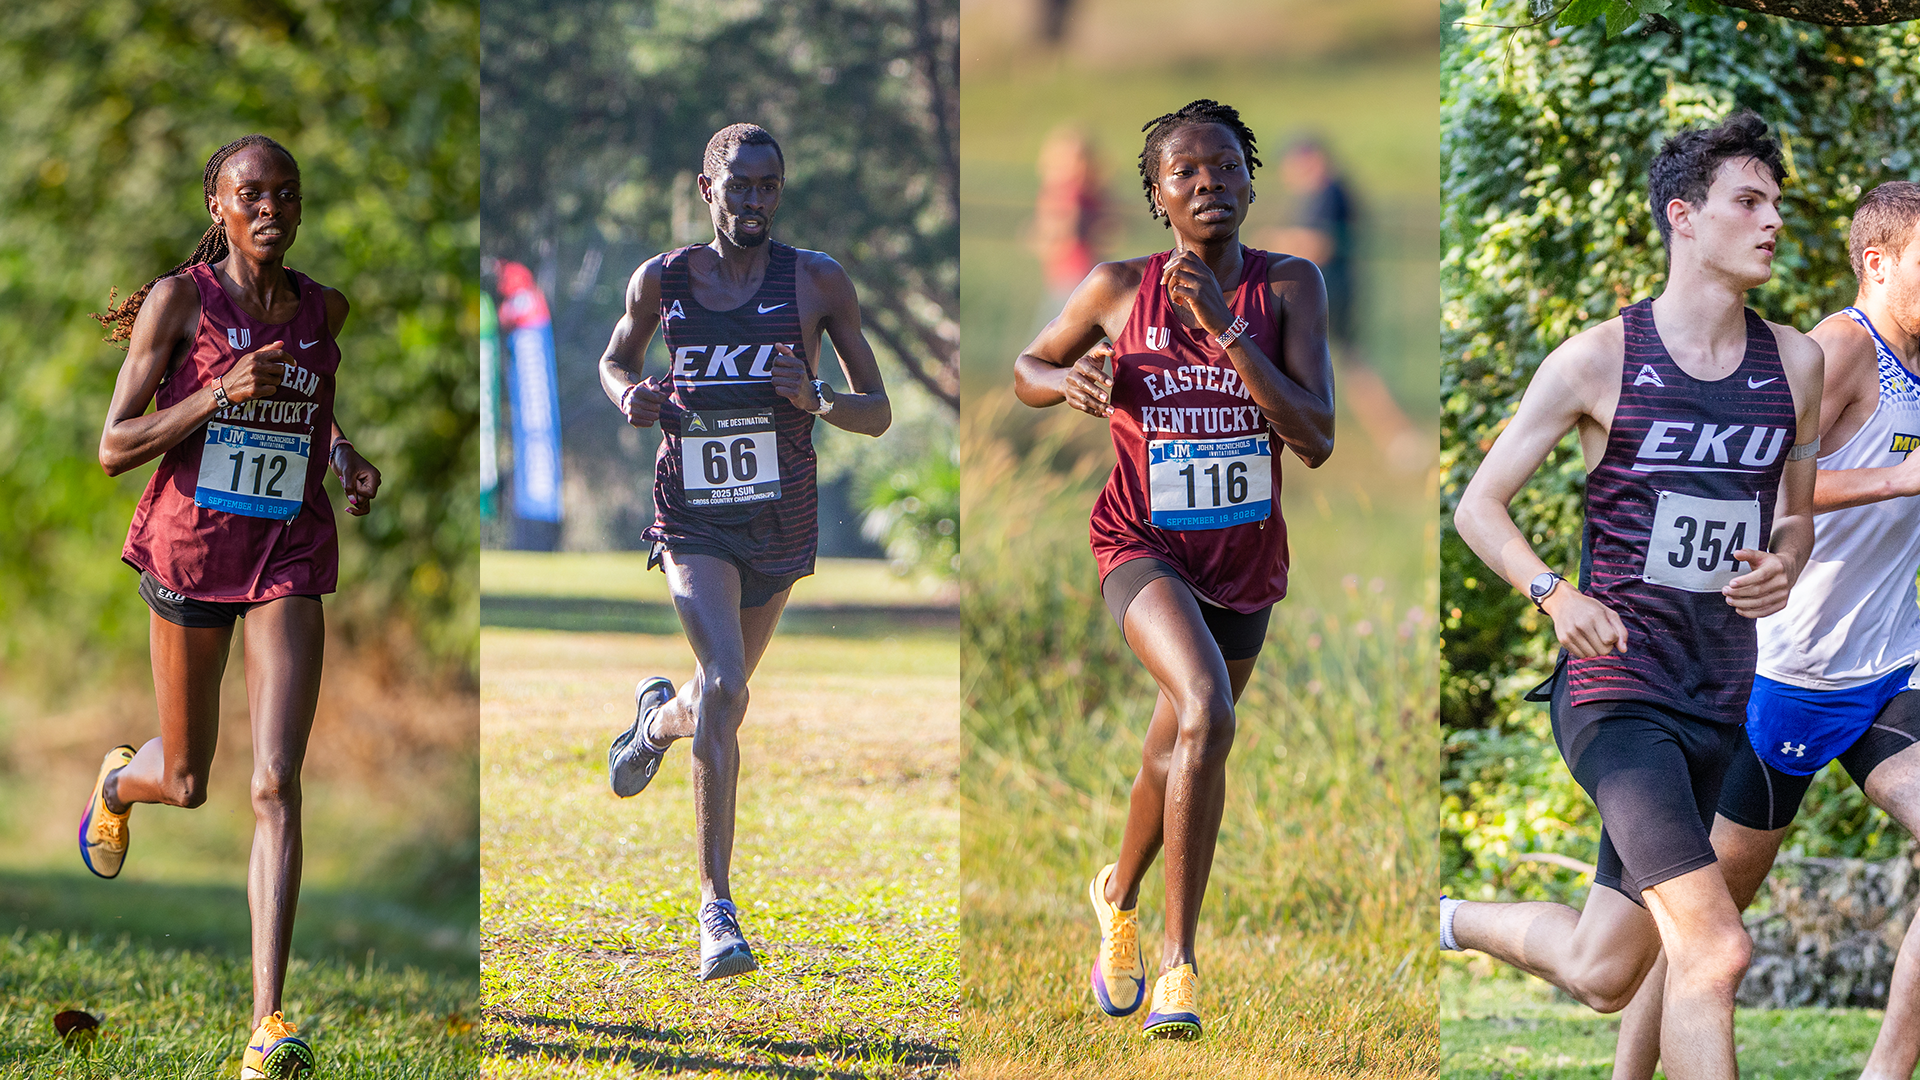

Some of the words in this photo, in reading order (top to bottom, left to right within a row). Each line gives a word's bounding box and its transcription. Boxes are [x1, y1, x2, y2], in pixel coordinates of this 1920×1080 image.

[717, 419, 730, 429] THE
[1141, 405, 1261, 434] KENTUCKY
[224, 429, 245, 445] JM
[250, 433, 266, 441] JOHN
[1635, 420, 1787, 467] EKU
[259, 441, 285, 450] INVITATIONAL
[1170, 444, 1191, 458] JM
[1208, 449, 1241, 457] INVITATIONAL
[702, 437, 758, 485] 66
[229, 450, 287, 497] 112
[711, 489, 731, 499] 2025
[733, 485, 755, 497] ASUN
[1179, 462, 1249, 508] 116
[208, 496, 252, 511] SEPTEMBER
[692, 498, 710, 506] CROSS
[710, 497, 733, 505] COUNTRY
[1166, 516, 1215, 526] SEPTEMBER
[1667, 516, 1747, 572] 354
[158, 587, 186, 601] EKU
